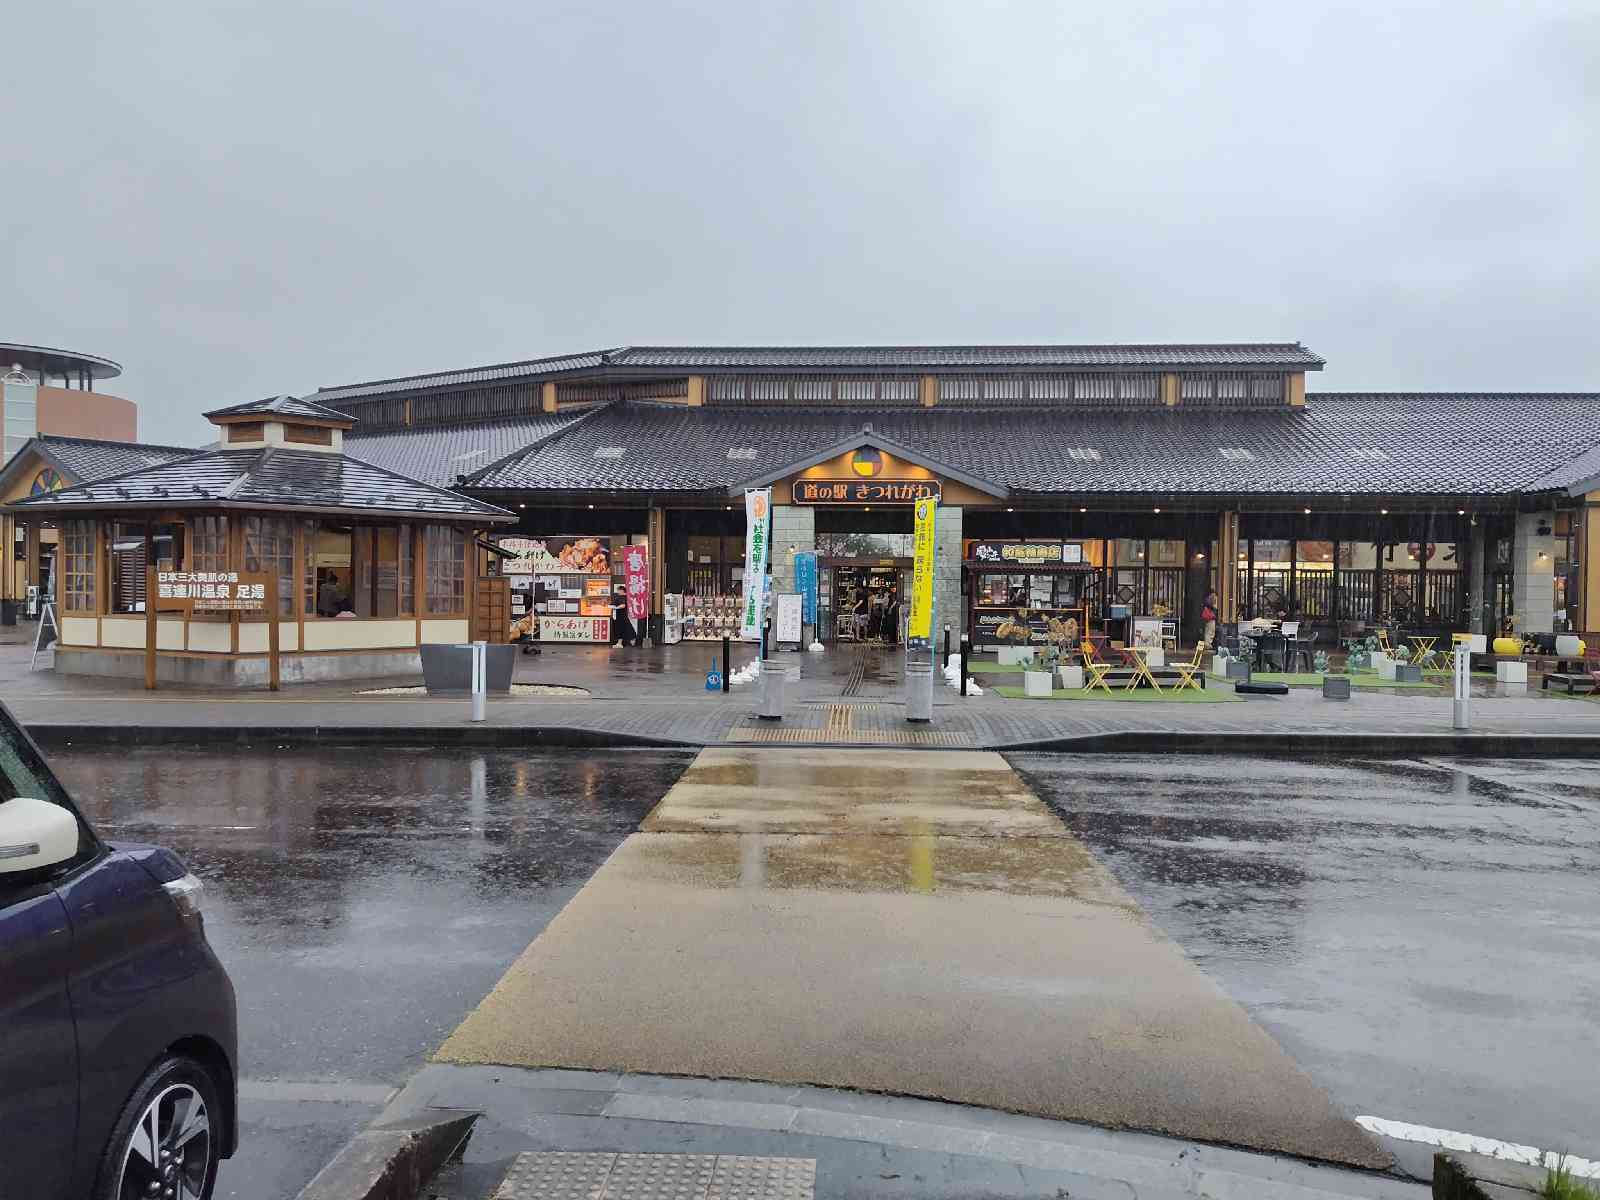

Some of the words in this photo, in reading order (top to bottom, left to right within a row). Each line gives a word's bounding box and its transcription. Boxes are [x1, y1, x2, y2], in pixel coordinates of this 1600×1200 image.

[804, 484, 847, 499] 道の駅
[856, 484, 931, 500] きつれがわ
[158, 584, 230, 599] 喜連川温泉
[236, 584, 265, 599] 足湯
